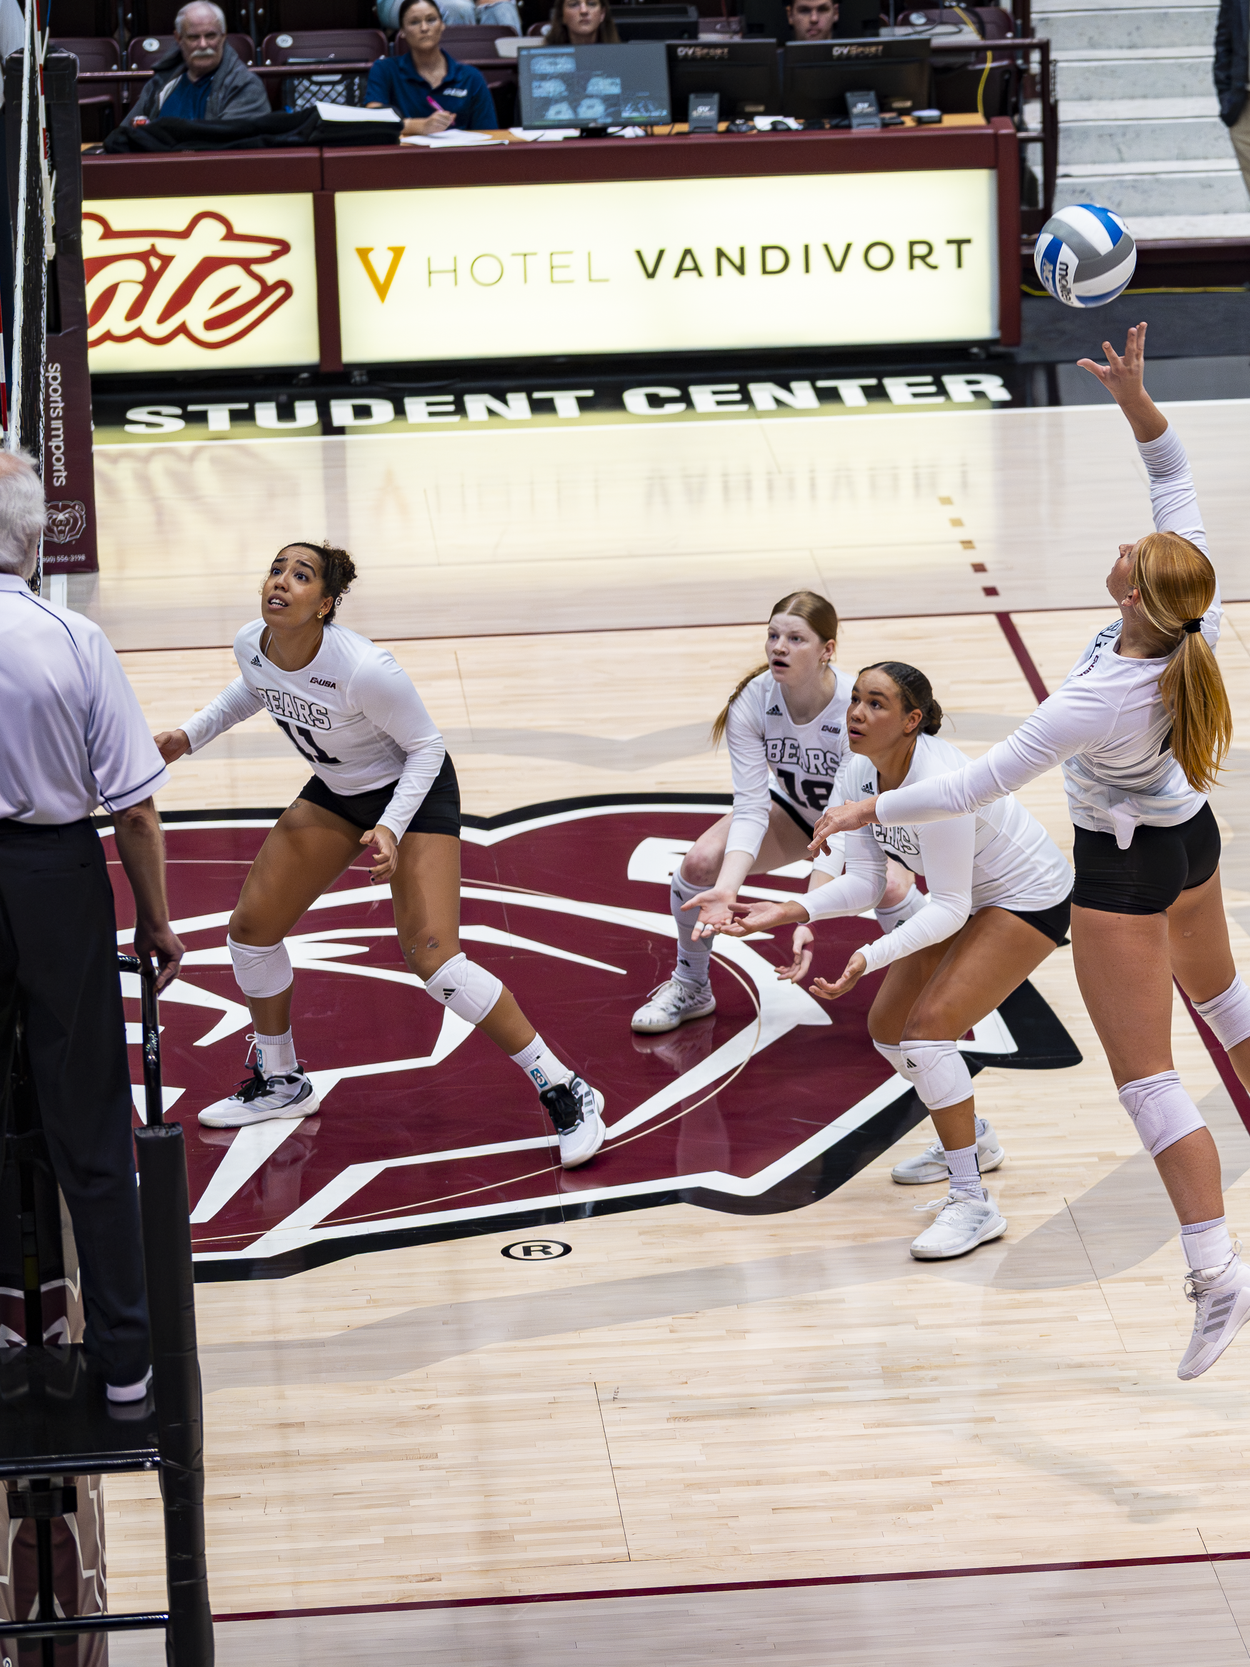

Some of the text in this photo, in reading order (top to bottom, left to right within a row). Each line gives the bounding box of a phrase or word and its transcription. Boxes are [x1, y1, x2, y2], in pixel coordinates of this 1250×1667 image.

[82, 211, 293, 350] ate
[355, 239, 972, 304] V HOTEL VANDIVORT
[46, 362, 67, 487] sports imports
[124, 373, 1012, 434] STUDENT CENTER
[256, 687, 332, 730] BEARS
[276, 718, 342, 764] 11
[871, 822, 920, 855] EARS
